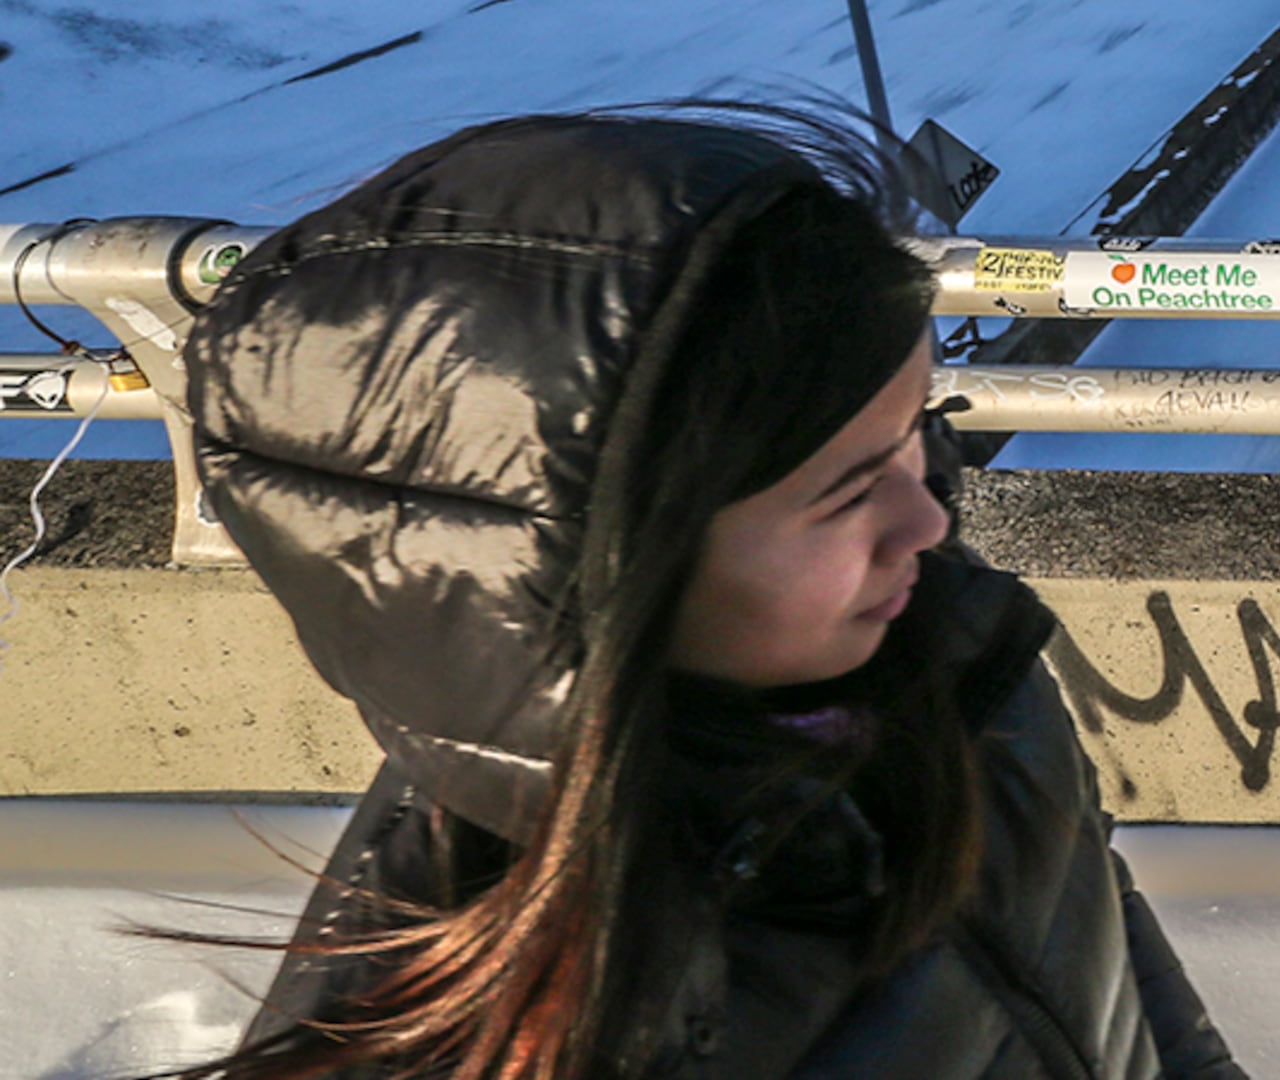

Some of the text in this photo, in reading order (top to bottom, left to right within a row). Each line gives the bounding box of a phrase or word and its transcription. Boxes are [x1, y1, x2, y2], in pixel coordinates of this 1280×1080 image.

[1141, 263, 1257, 288] Meet Me
[1092, 286, 1273, 309] On Peachtree
